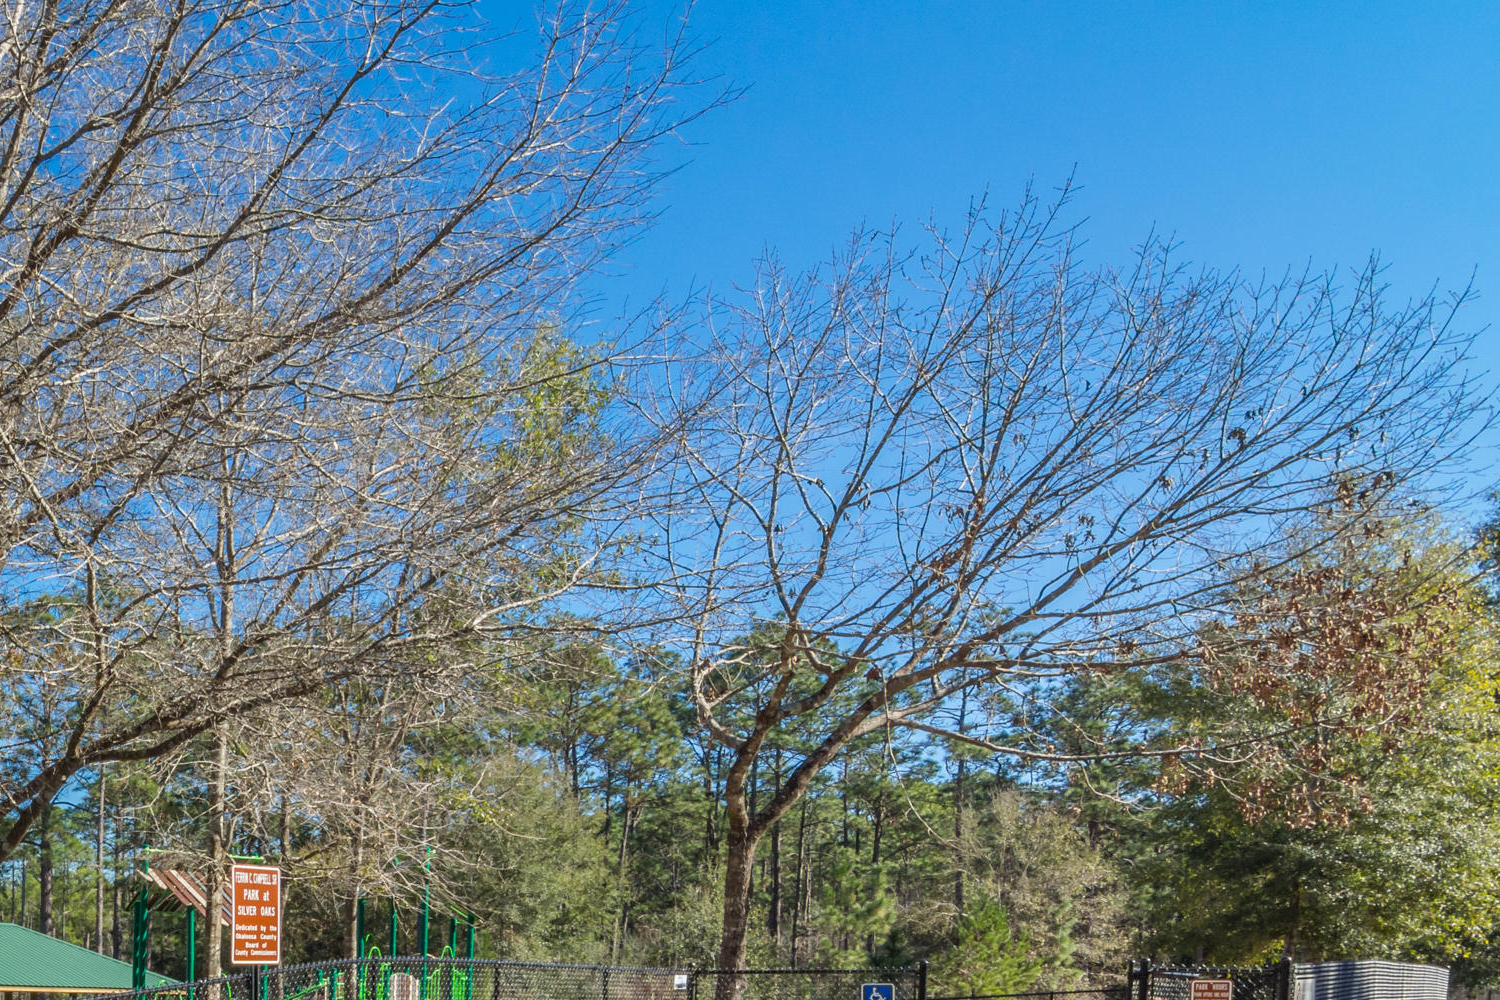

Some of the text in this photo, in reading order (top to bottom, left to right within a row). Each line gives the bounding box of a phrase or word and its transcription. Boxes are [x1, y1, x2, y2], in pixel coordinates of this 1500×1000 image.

[243, 889, 270, 901] PARK at
[237, 905, 276, 917] SILVER OAKS
[260, 925, 266, 933] by
[260, 933, 276, 941] County
